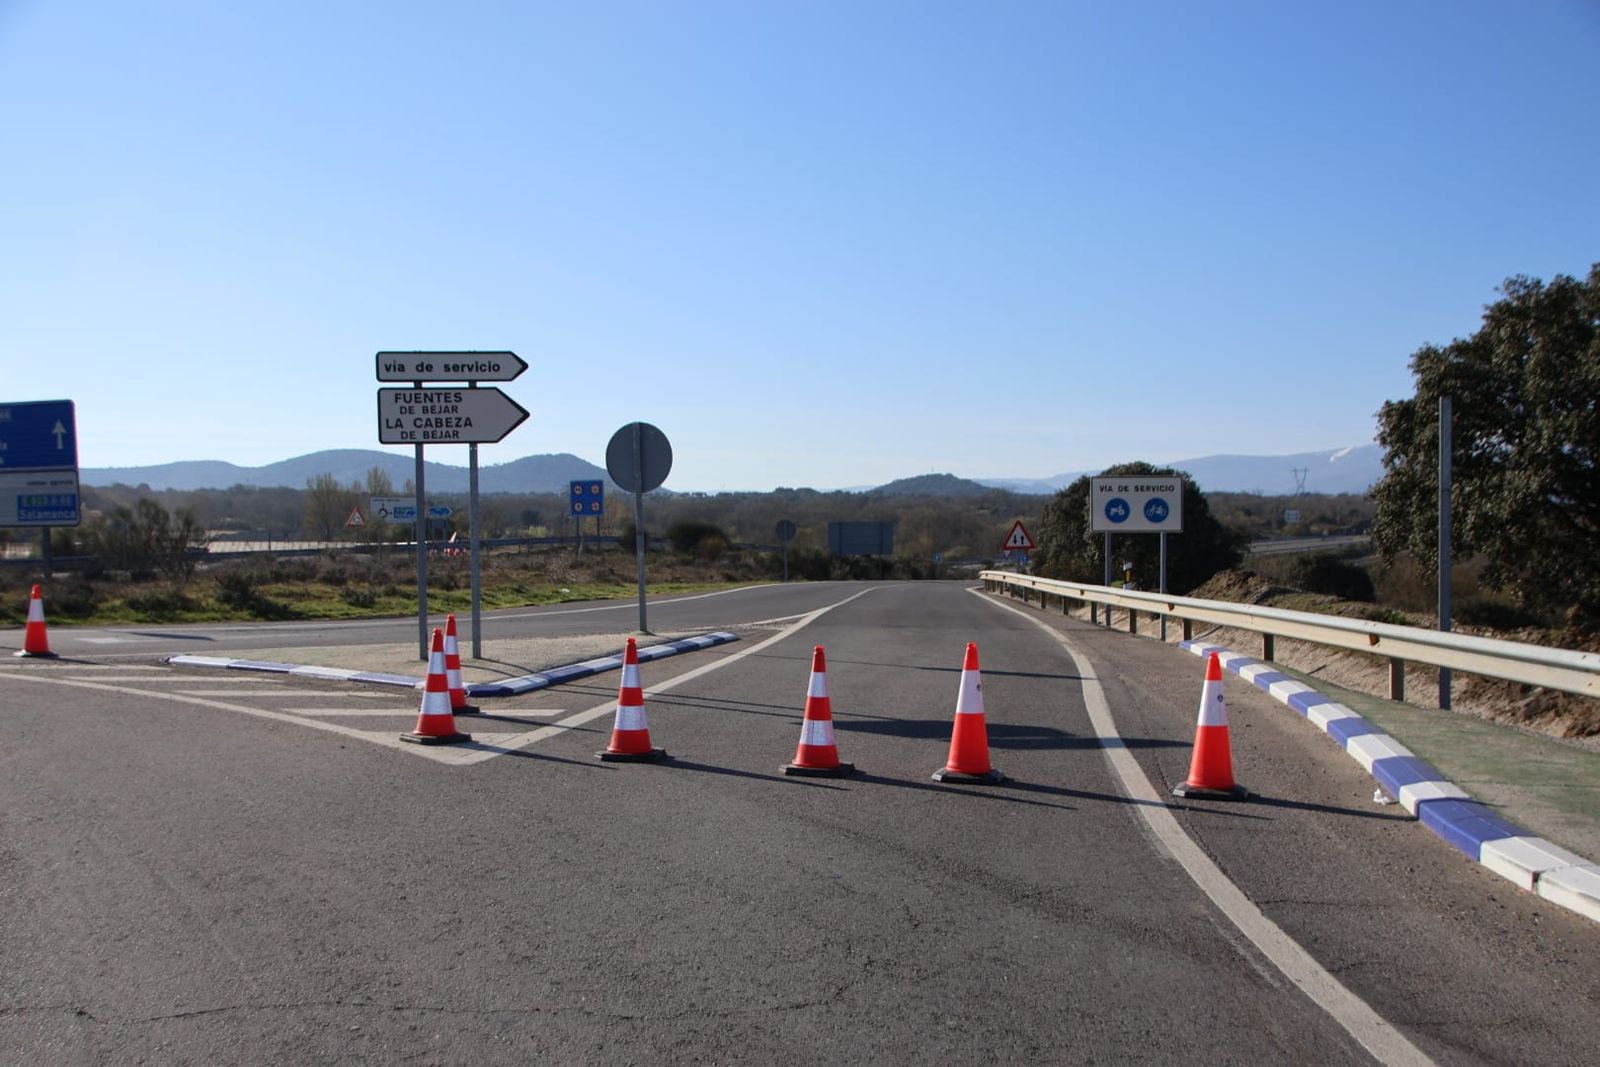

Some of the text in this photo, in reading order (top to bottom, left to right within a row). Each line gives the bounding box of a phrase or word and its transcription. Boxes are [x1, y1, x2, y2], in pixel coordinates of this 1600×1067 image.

[415, 361, 434, 372] de
[443, 361, 501, 372] servicio
[394, 393, 462, 403] FUENTES
[399, 406, 415, 415] DE
[385, 417, 472, 429] LA CABEZA
[400, 431, 416, 440] DE
